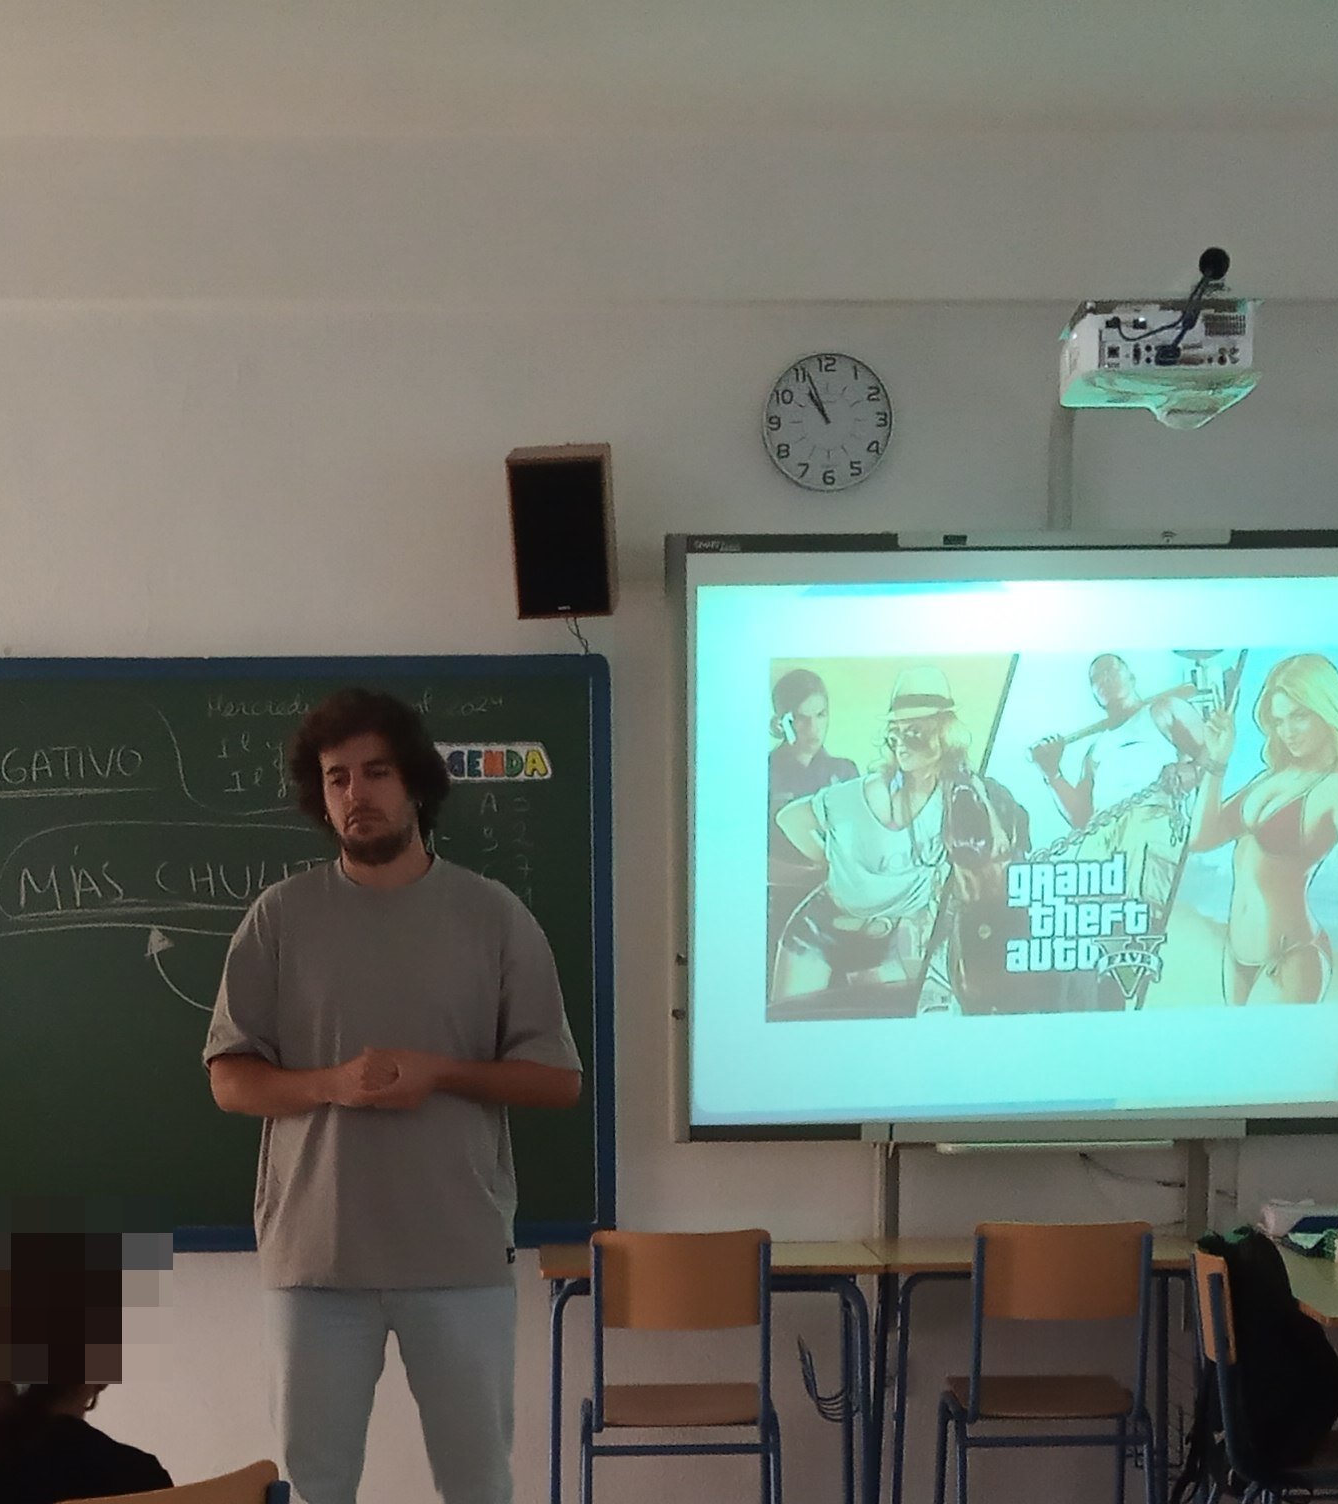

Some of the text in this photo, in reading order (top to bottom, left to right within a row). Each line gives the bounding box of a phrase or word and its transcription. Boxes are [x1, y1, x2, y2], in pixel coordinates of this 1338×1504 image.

[817, 357, 836, 372] 12
[794, 367, 807, 383] 11
[774, 389, 794, 404] 10
[867, 386, 881, 402] 2
[768, 415, 781, 431] 9
[876, 411, 888, 428] 3
[776, 443, 790, 459] 8
[867, 440, 882, 455] 4
[797, 463, 810, 479] 7
[850, 461, 862, 476] 5
[822, 470, 836, 485] 6
[447, 749, 549, 777] GENDA
[19, 845, 124, 911] MÁS
[1006, 938, 1101, 972] auto
